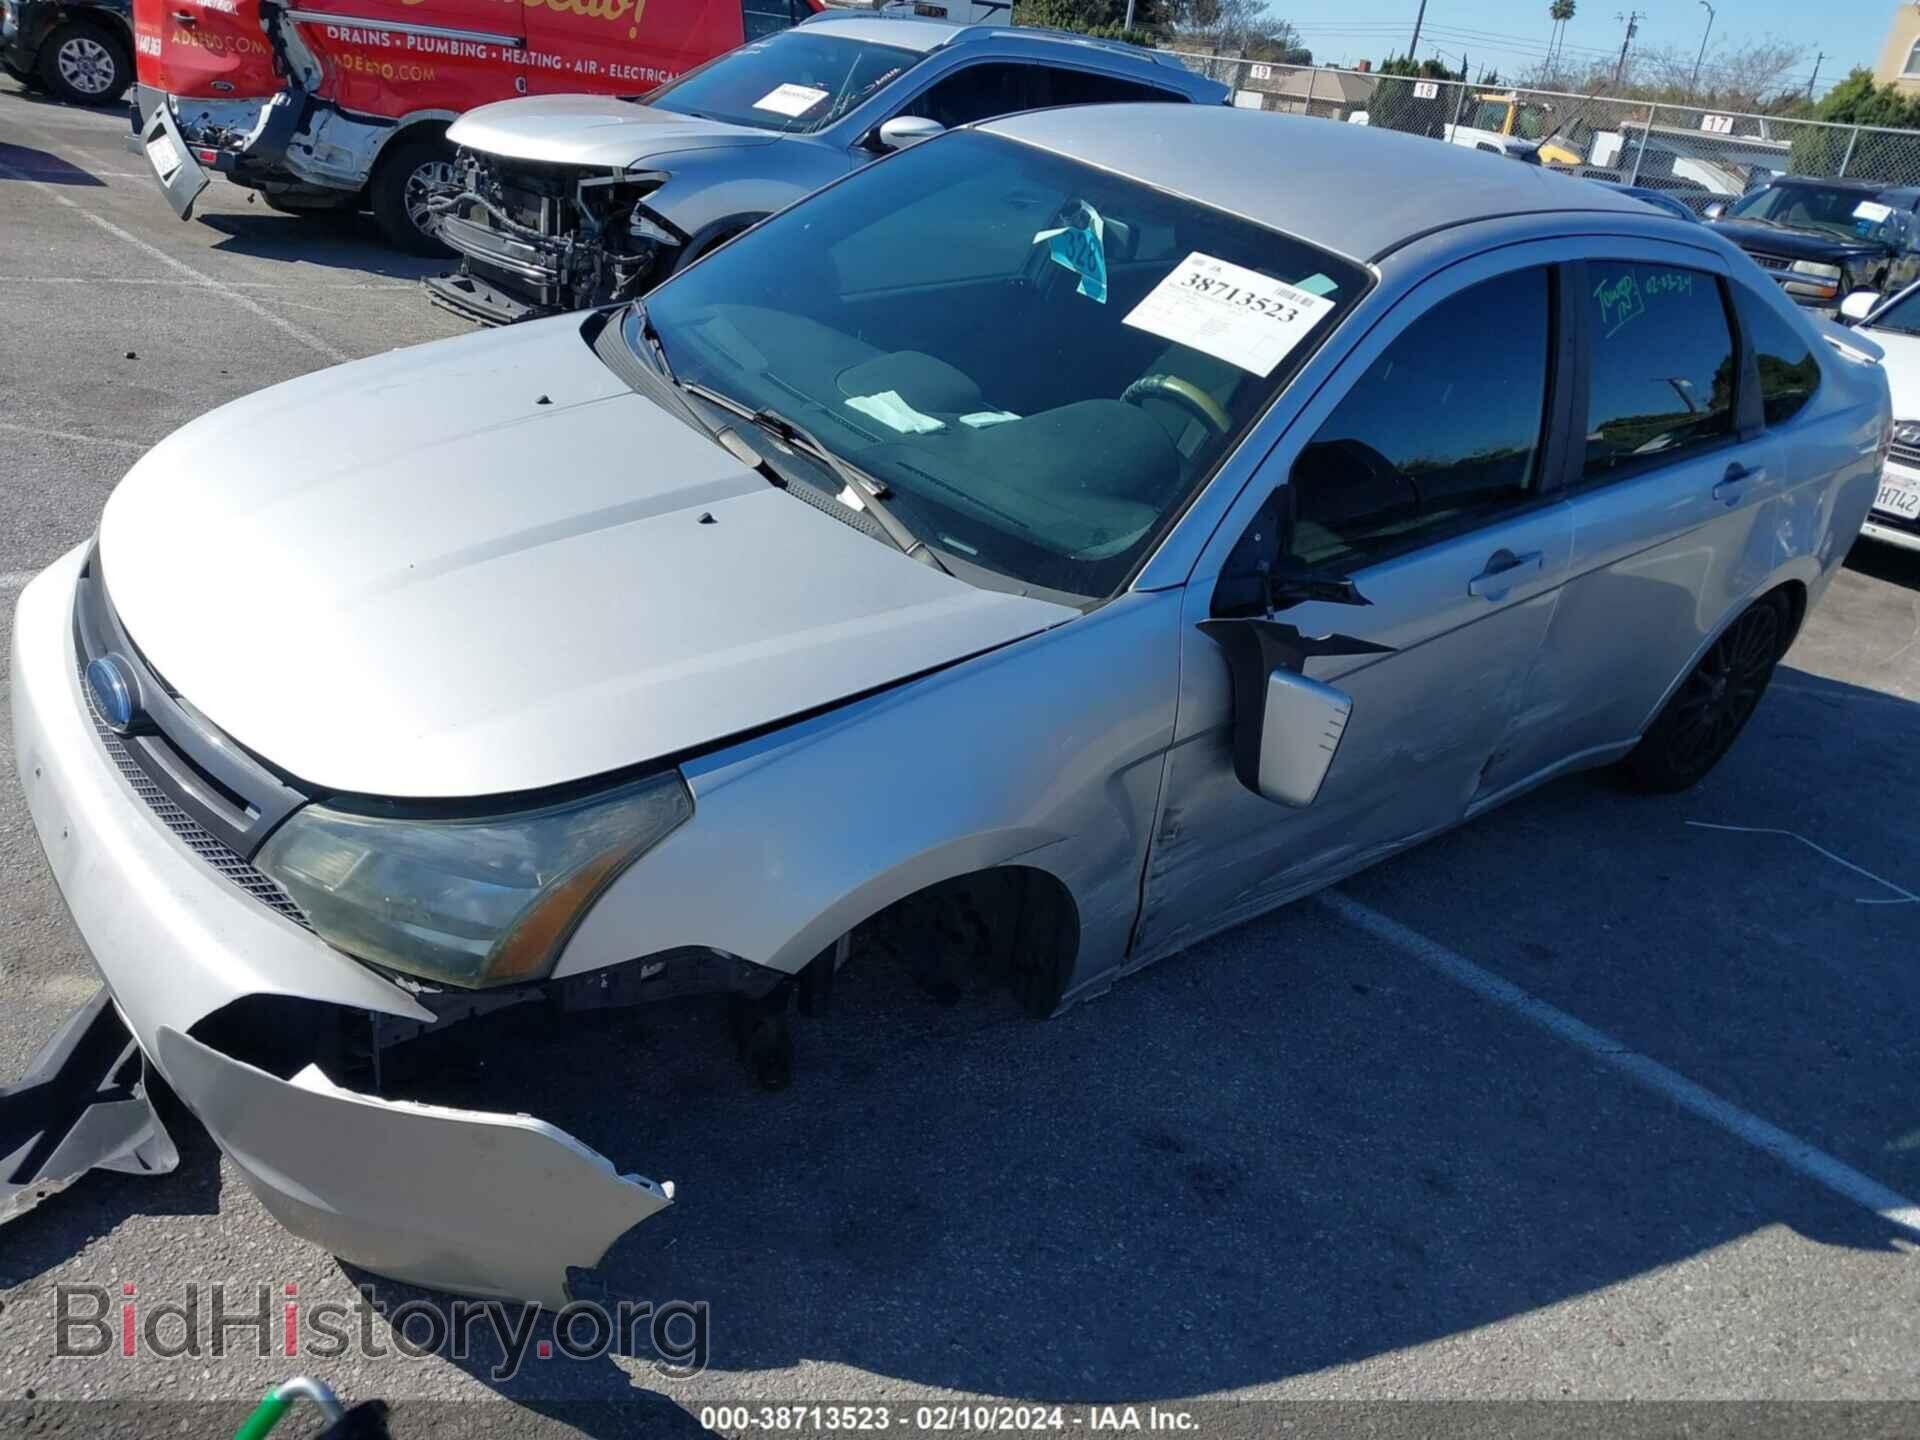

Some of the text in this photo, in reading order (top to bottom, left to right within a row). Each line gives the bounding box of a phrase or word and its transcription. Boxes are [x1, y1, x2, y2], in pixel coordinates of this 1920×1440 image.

[327, 25, 391, 47] DRAINS
[406, 36, 488, 60] PLUMBING
[502, 50, 562, 70] HEATING
[574, 60, 598, 74] AIR
[1254, 66, 1268, 78] 19
[1418, 84, 1434, 97] 18
[1709, 116, 1729, 131] 17
[1180, 271, 1300, 323] 38713523
